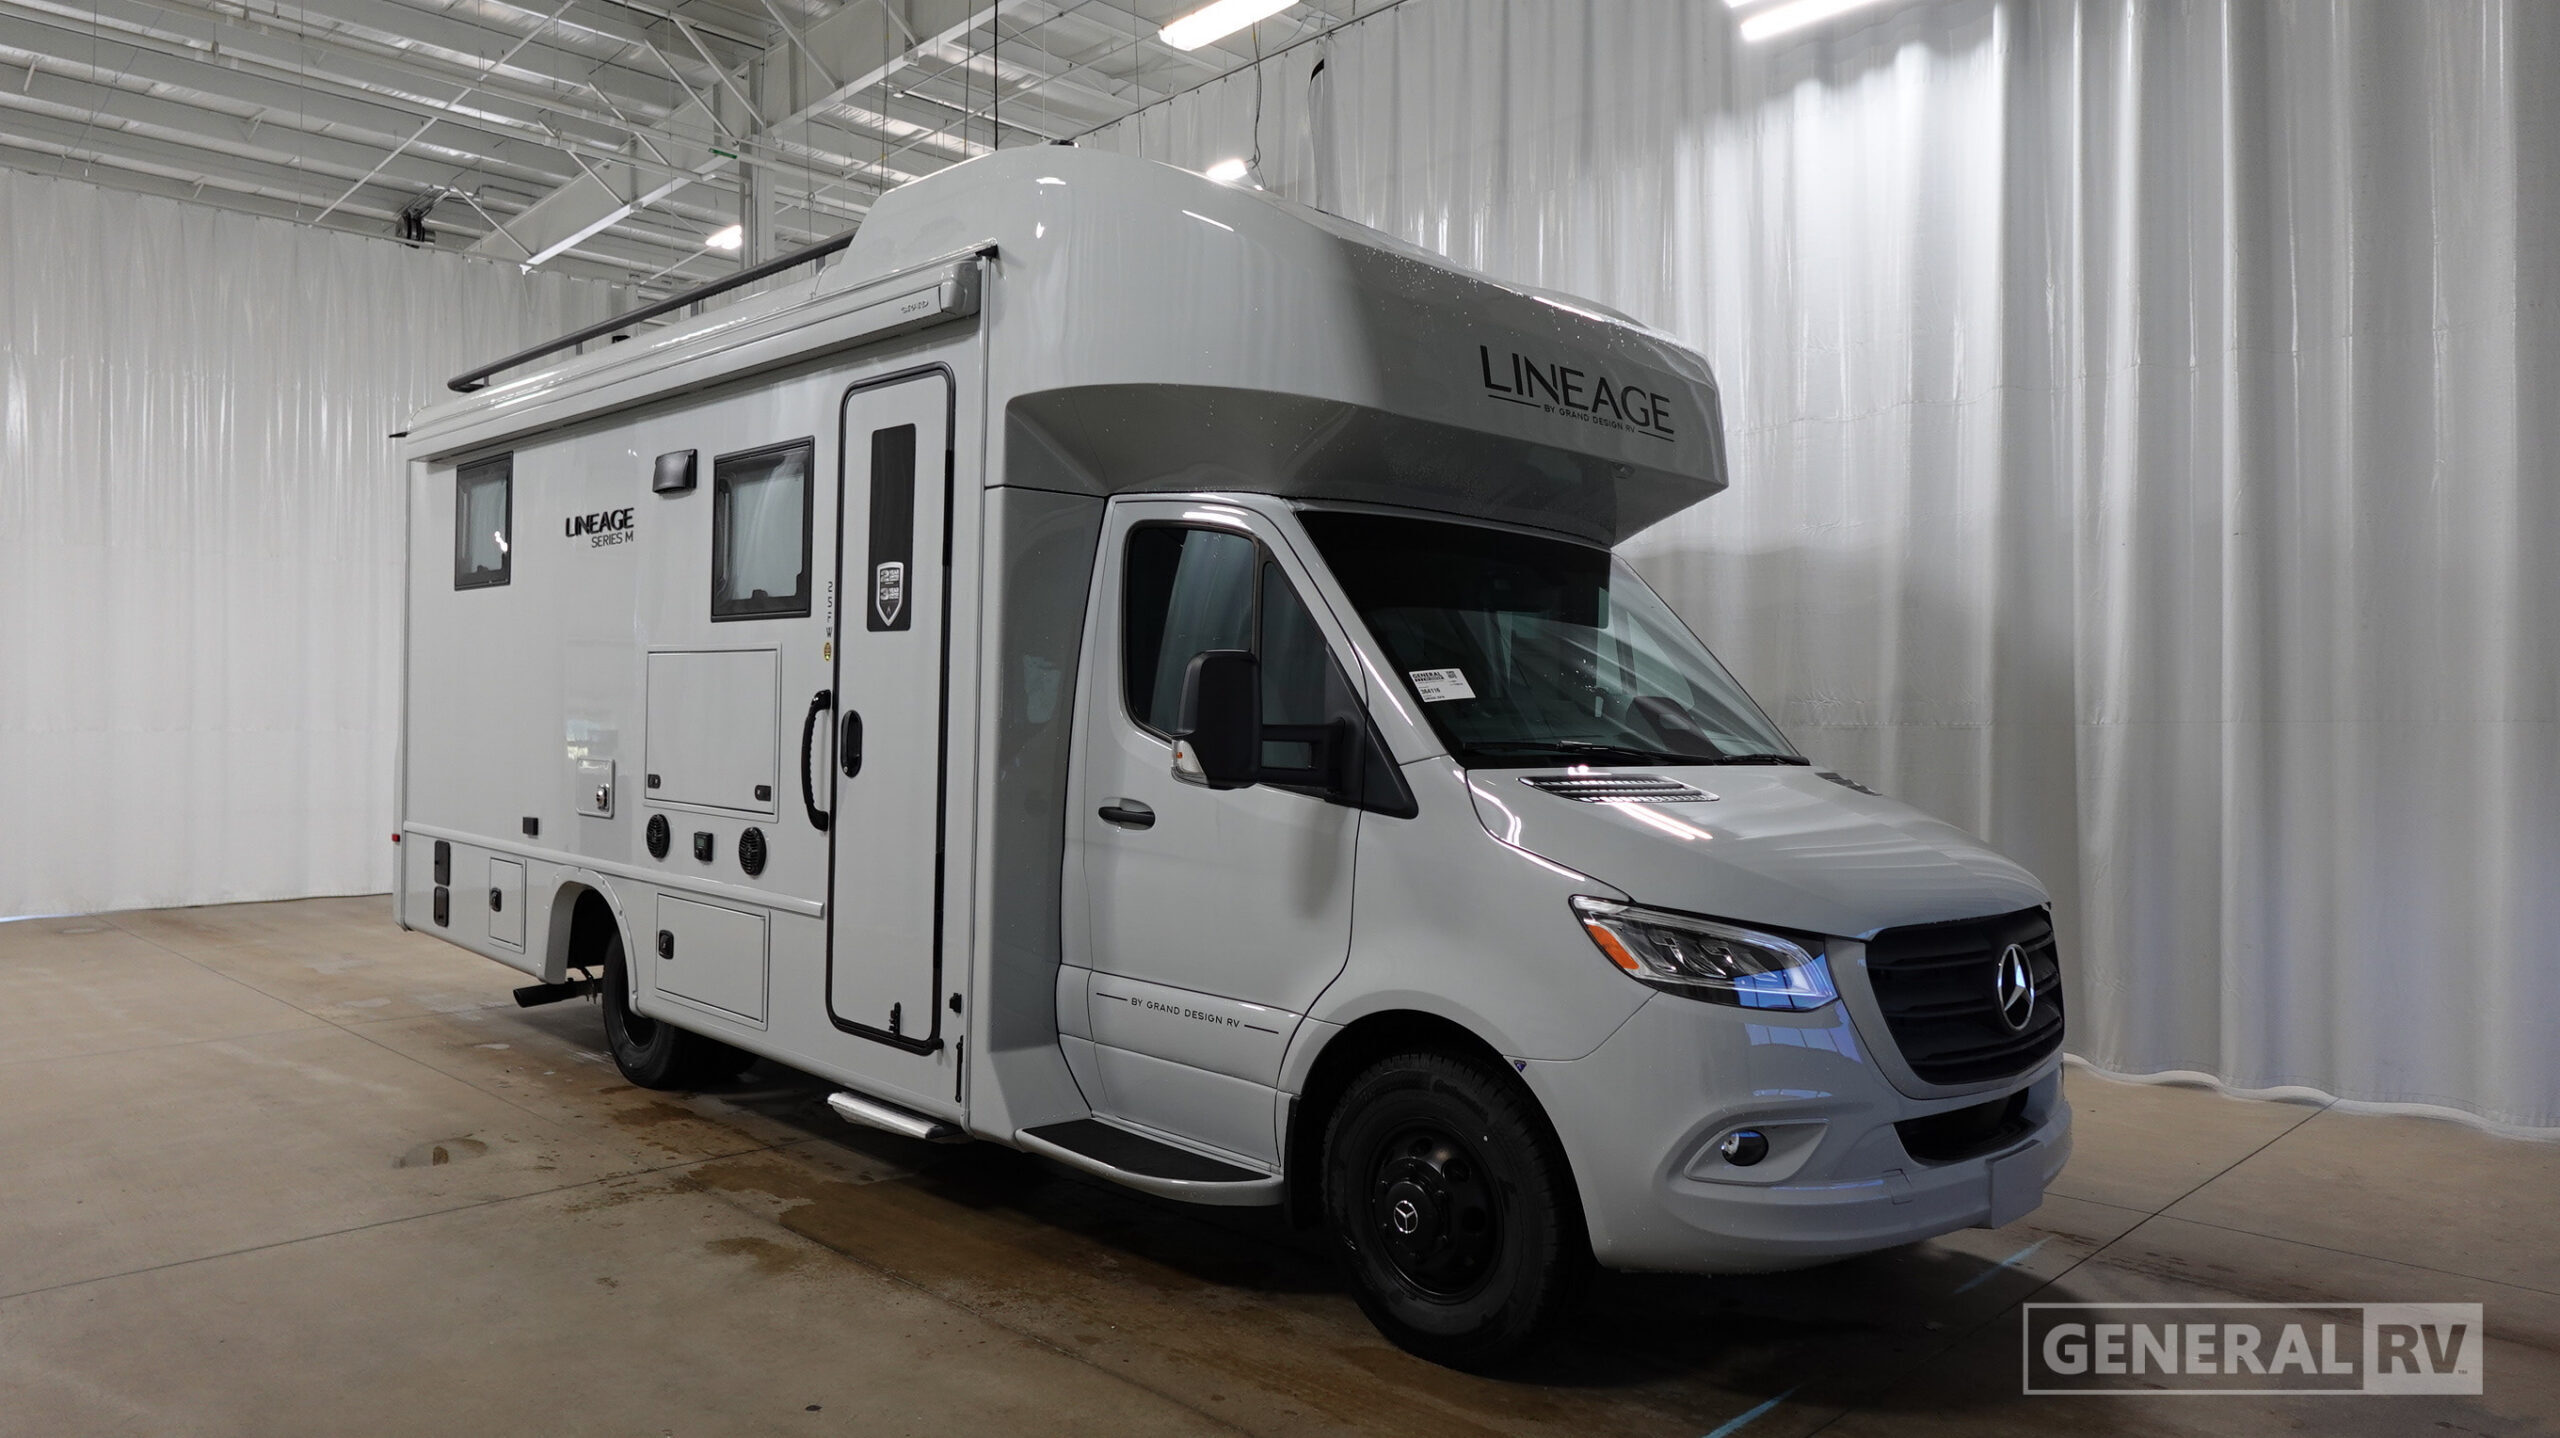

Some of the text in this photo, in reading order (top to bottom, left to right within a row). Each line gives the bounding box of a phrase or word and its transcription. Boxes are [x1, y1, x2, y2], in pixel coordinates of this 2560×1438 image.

[1479, 345, 1675, 435] LINEAGE
[1543, 404, 1636, 434] BY GRAND DESIGN RV
[565, 507, 635, 538] LINEAGE
[591, 530, 634, 548] SERIES M
[1131, 997, 1240, 1028] BY GRAND DESIGN RV
